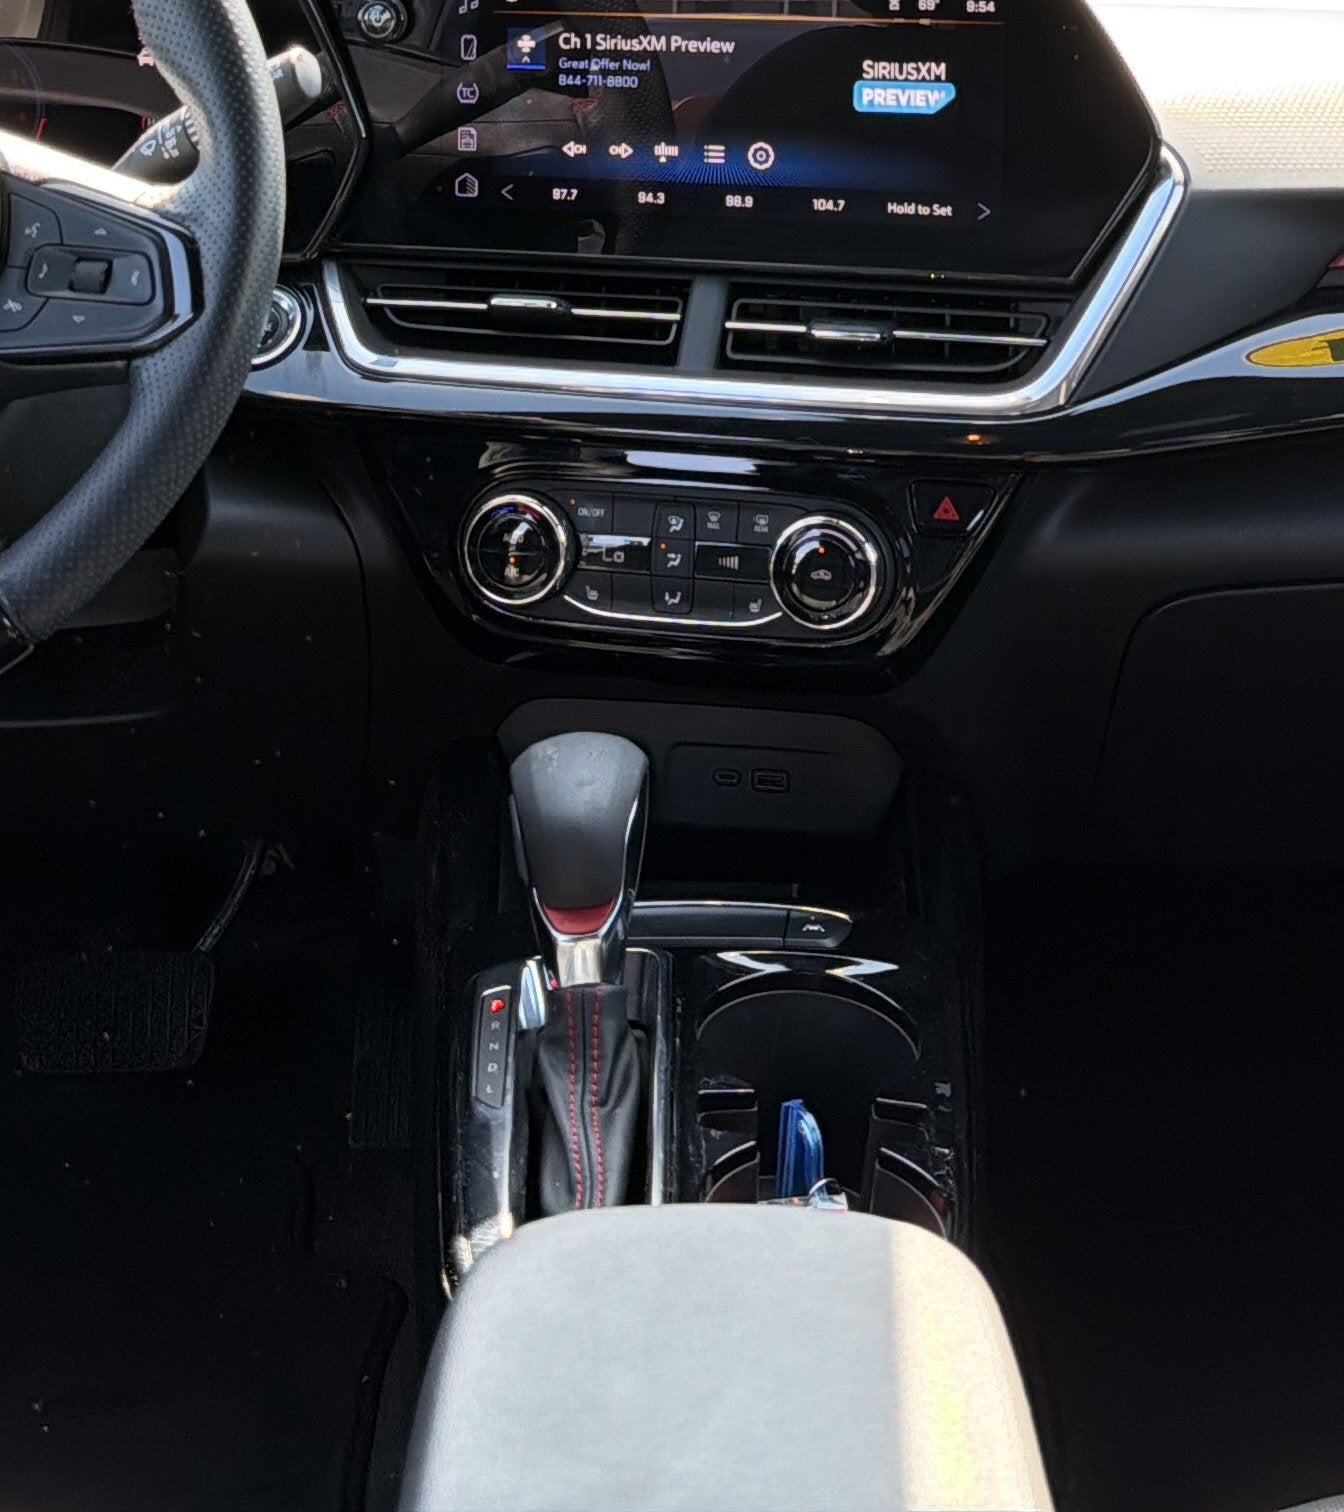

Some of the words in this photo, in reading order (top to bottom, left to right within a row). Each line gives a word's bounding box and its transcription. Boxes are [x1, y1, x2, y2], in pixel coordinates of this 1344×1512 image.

[966, 0, 996, 13] 9:54
[558, 32, 581, 51] Ch
[584, 33, 592, 51] 1
[595, 32, 667, 53] SiriusXM
[670, 35, 736, 54] Preview
[558, 58, 589, 71] Great
[591, 58, 620, 72] Offer
[862, 87, 946, 107] PREVIEW
[812, 198, 846, 212] 104.7
[887, 201, 915, 215] Hold
[917, 203, 930, 215] to
[932, 204, 953, 216] Set
[577, 506, 605, 518] ON/OFF
[489, 1042, 499, 1051] N
[487, 1062, 498, 1073] D
